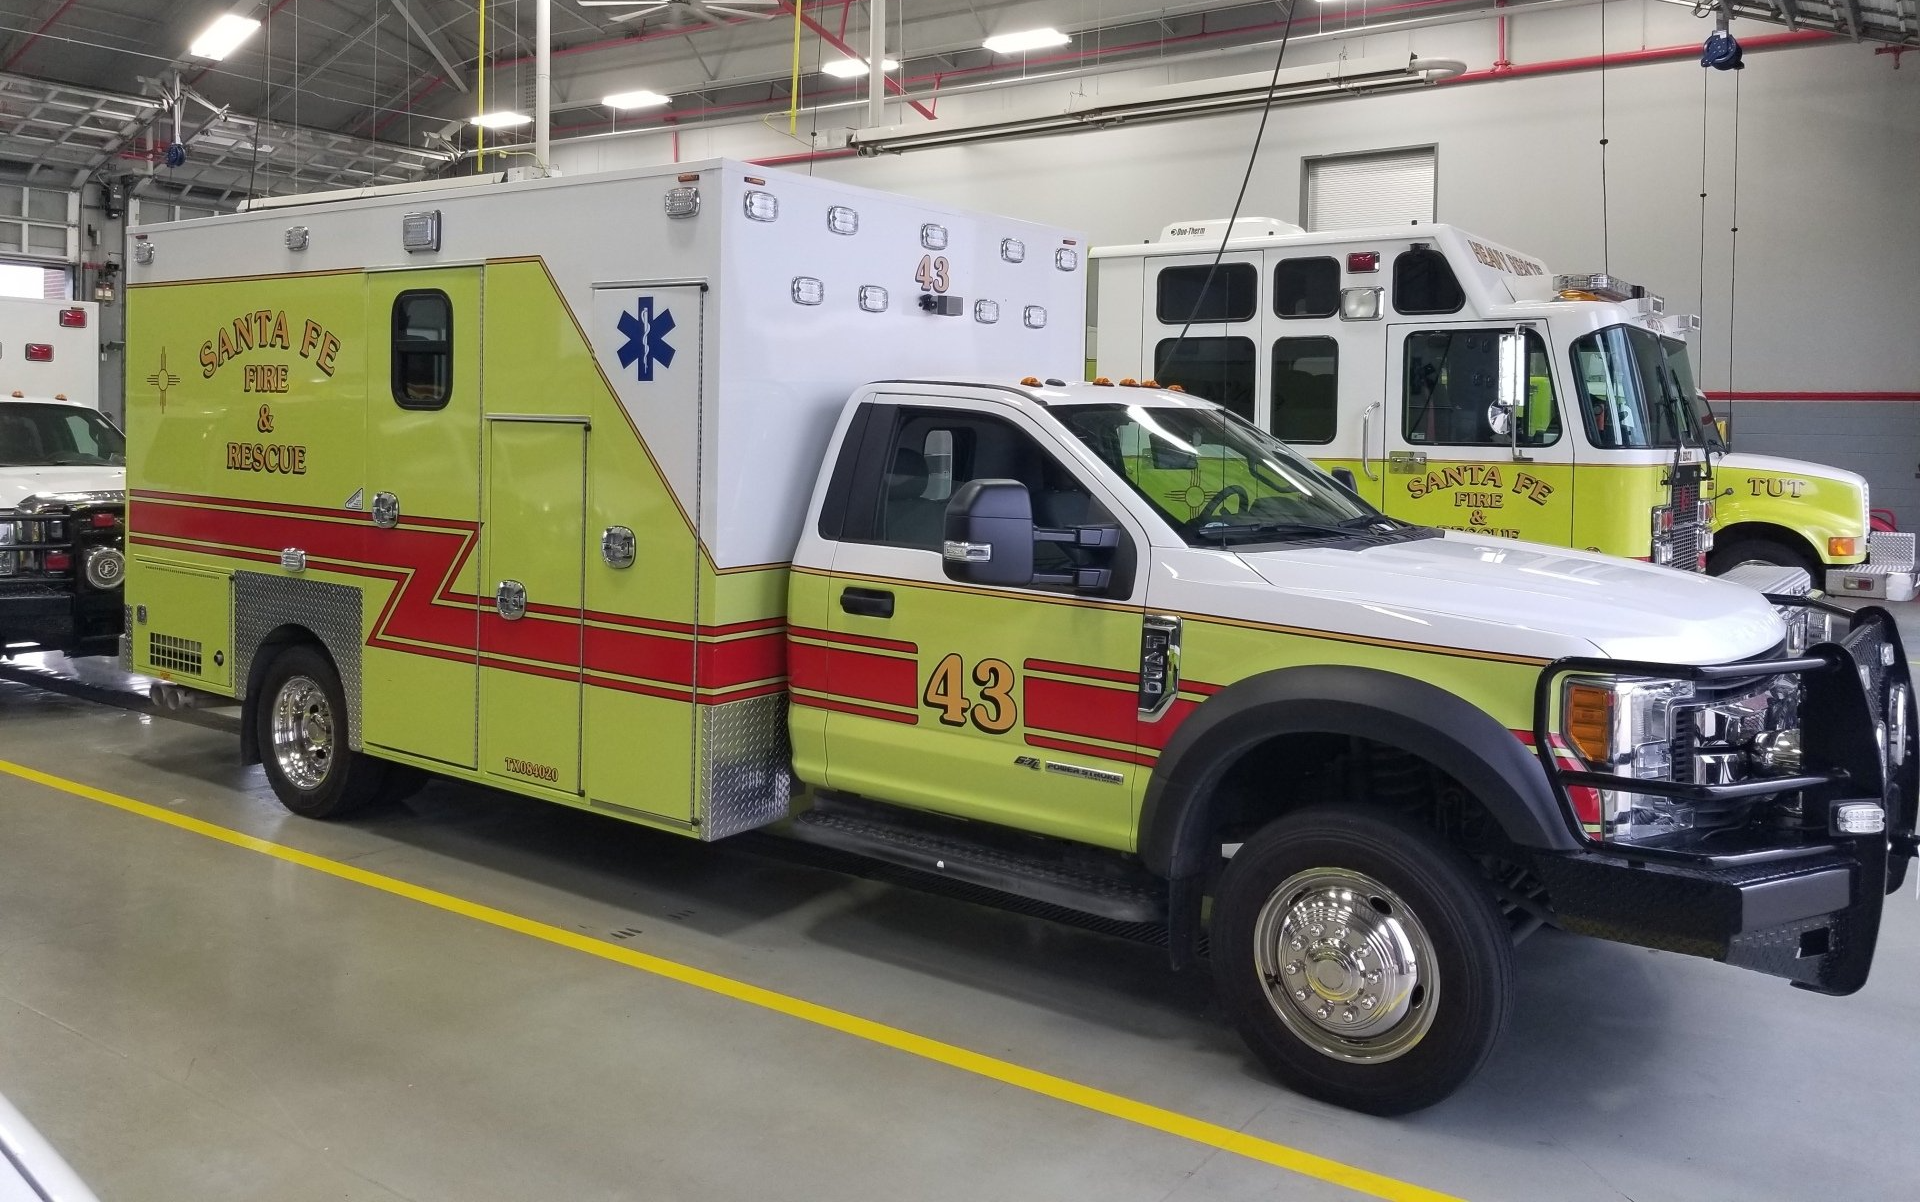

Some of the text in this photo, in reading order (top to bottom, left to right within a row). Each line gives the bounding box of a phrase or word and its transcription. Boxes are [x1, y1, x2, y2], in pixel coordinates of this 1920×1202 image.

[1467, 239, 1512, 273] HEAVY
[915, 254, 949, 293] 43
[199, 310, 341, 379] SANTA FE
[244, 365, 289, 393] FIRE
[257, 404, 274, 433] &
[227, 442, 306, 475] RESCUE
[1407, 465, 1554, 506] SANTA FE
[1454, 492, 1504, 508] FIRE
[1747, 477, 1806, 498] TUT
[1470, 509, 1487, 525] &
[923, 653, 1018, 735] 43
[505, 757, 559, 782] TX084020
[1047, 762, 1080, 774] POWER
[1081, 769, 1121, 783] STROKE
